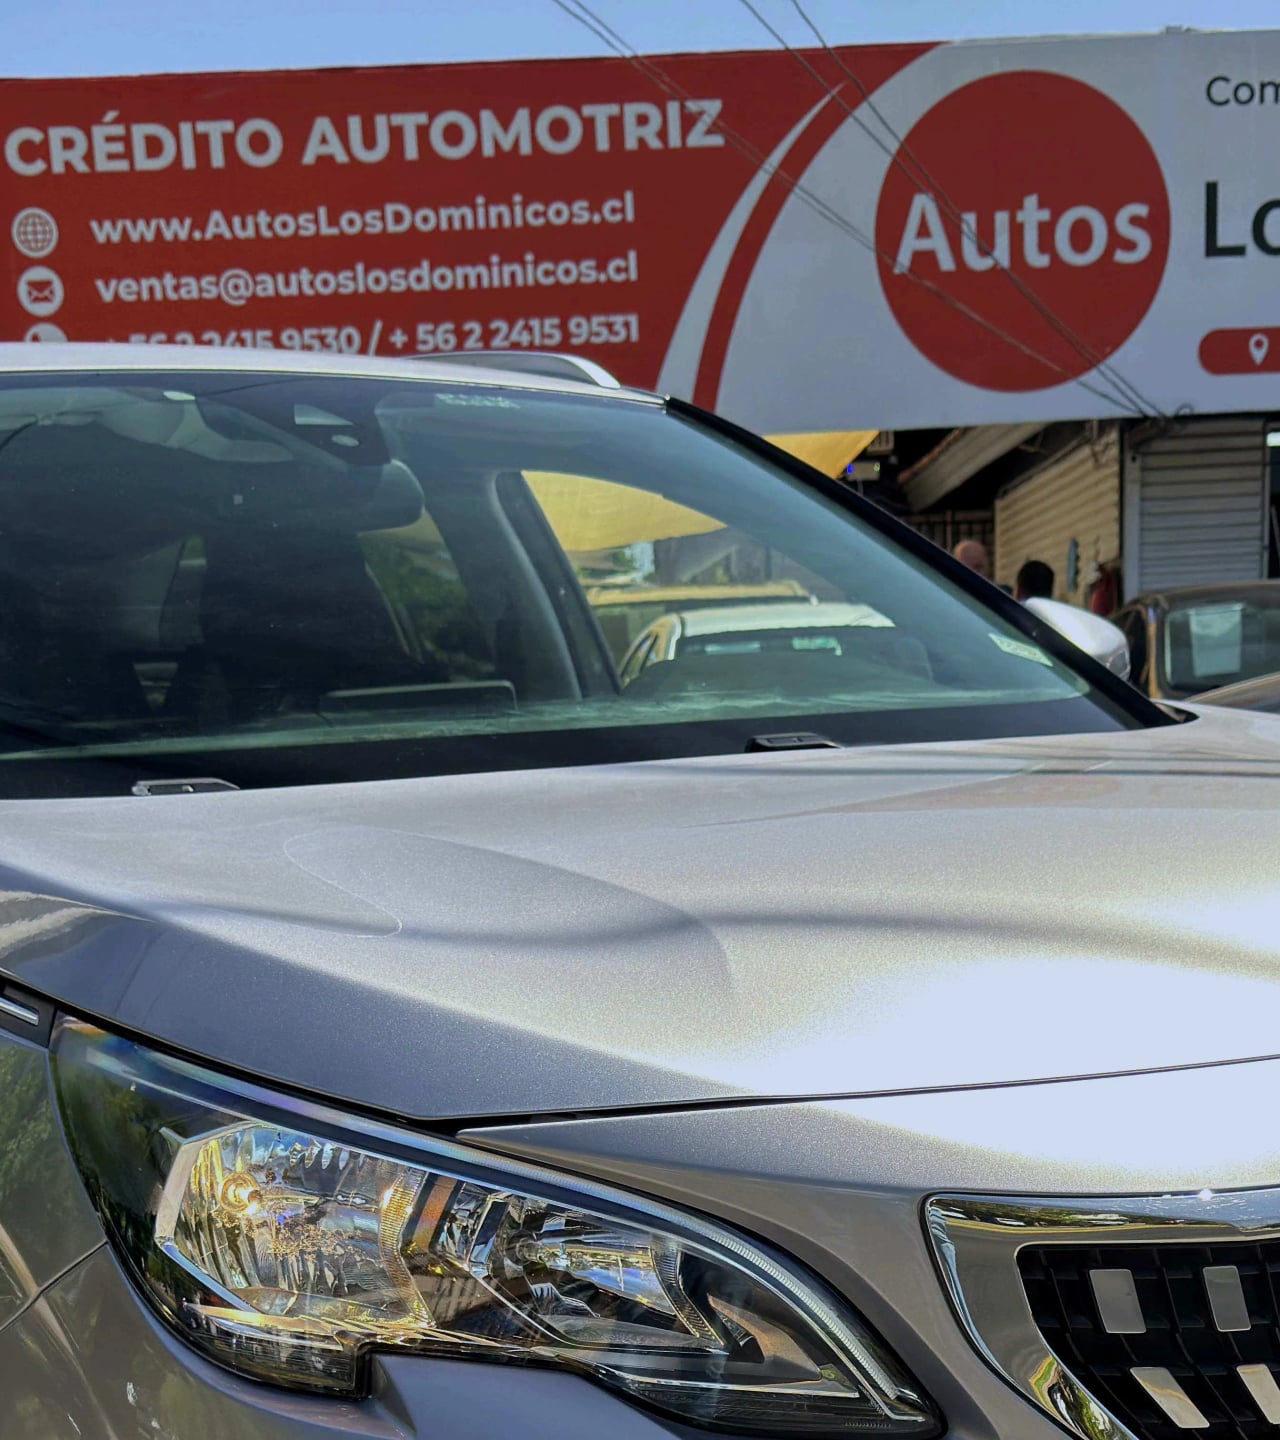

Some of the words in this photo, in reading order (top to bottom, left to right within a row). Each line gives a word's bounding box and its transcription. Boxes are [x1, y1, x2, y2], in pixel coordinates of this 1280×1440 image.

[4, 110, 283, 176] CRÉDITO
[301, 98, 725, 165] AUTOMOTRIZ
[89, 190, 636, 244] www.AutosLosDominicos.cl
[893, 192, 1152, 275] Autos
[95, 250, 639, 306] ventas@autoslosdominicos.cl
[280, 326, 361, 354] 9530
[416, 322, 457, 351] 56
[463, 320, 483, 349] 2
[489, 317, 562, 348] 2415
[568, 313, 639, 345] 9531
